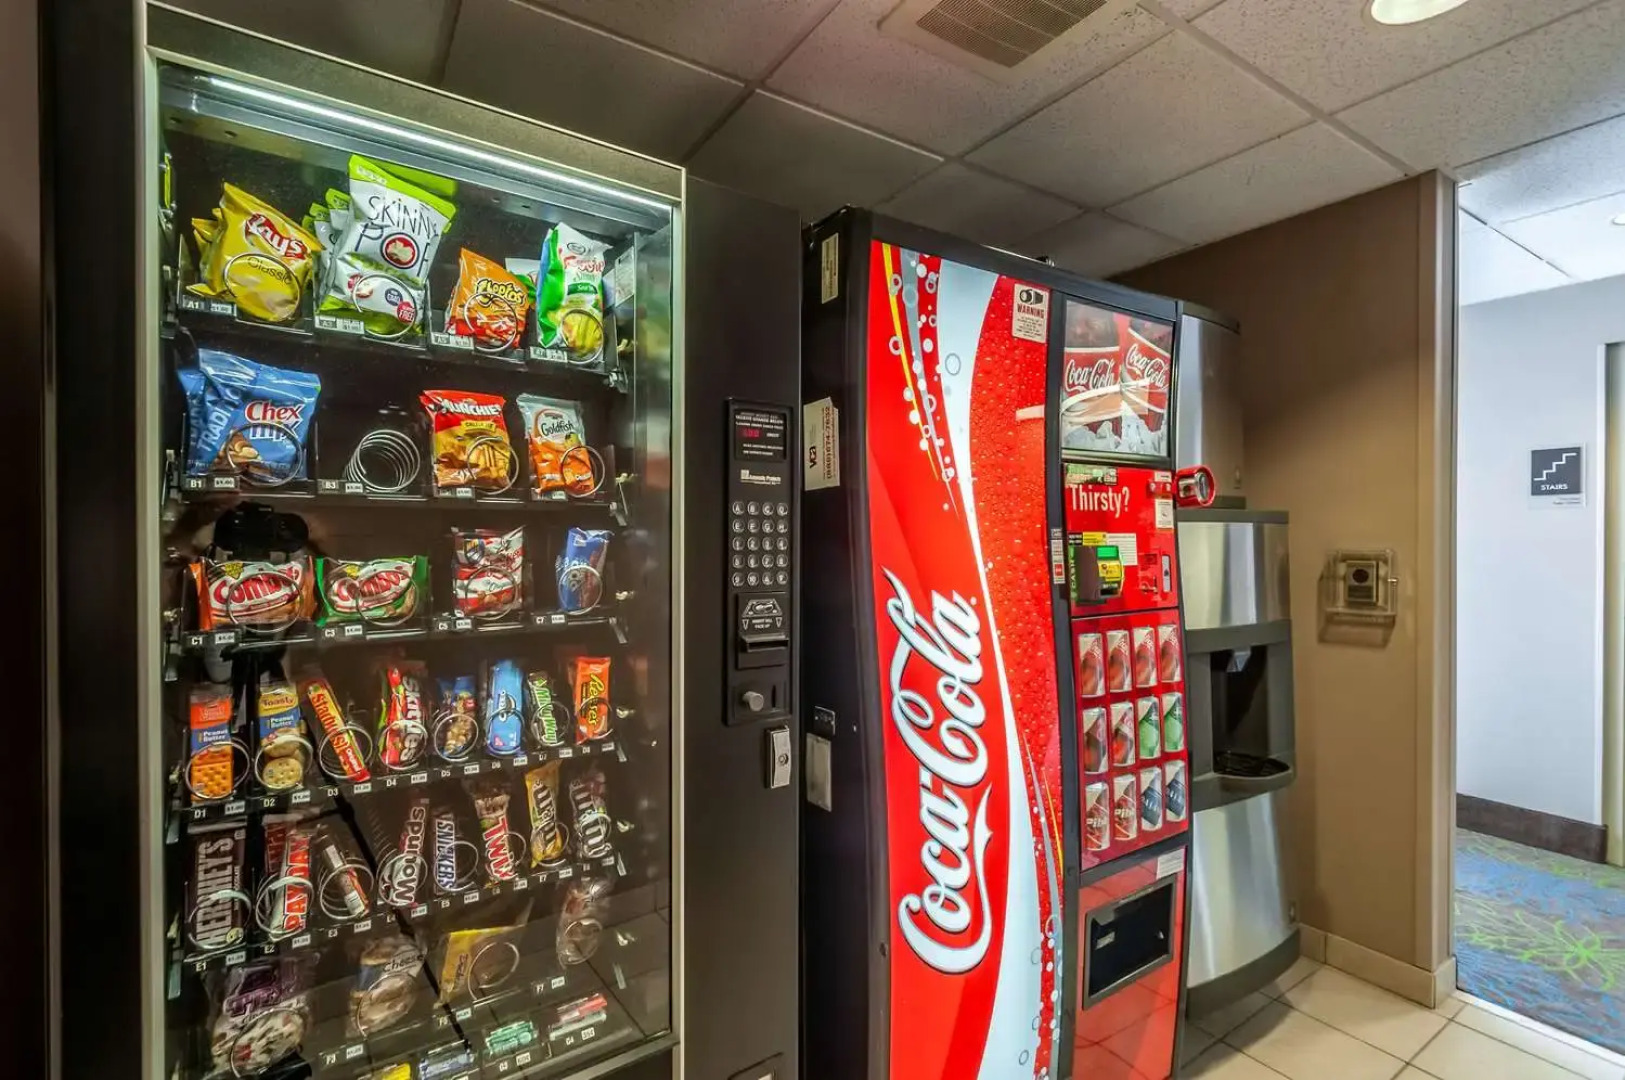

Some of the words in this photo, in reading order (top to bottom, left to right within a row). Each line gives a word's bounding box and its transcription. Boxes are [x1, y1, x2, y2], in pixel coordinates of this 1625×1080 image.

[247, 256, 292, 285] Classic
[1017, 303, 1044, 319] WARNING
[245, 401, 304, 424] Chex
[541, 420, 574, 437] Goldfish
[1541, 483, 1568, 491] STAIRS
[1068, 484, 1130, 518] Thirsty?
[203, 730, 228, 738] Peanut
[881, 565, 993, 974] Coca-Cola
[194, 808, 206, 818] D1
[264, 798, 275, 808] D2
[392, 806, 426, 903] Mounds
[436, 820, 456, 889] SNICKERS
[196, 837, 234, 947] HERSHEY'S
[196, 962, 207, 971] E1
